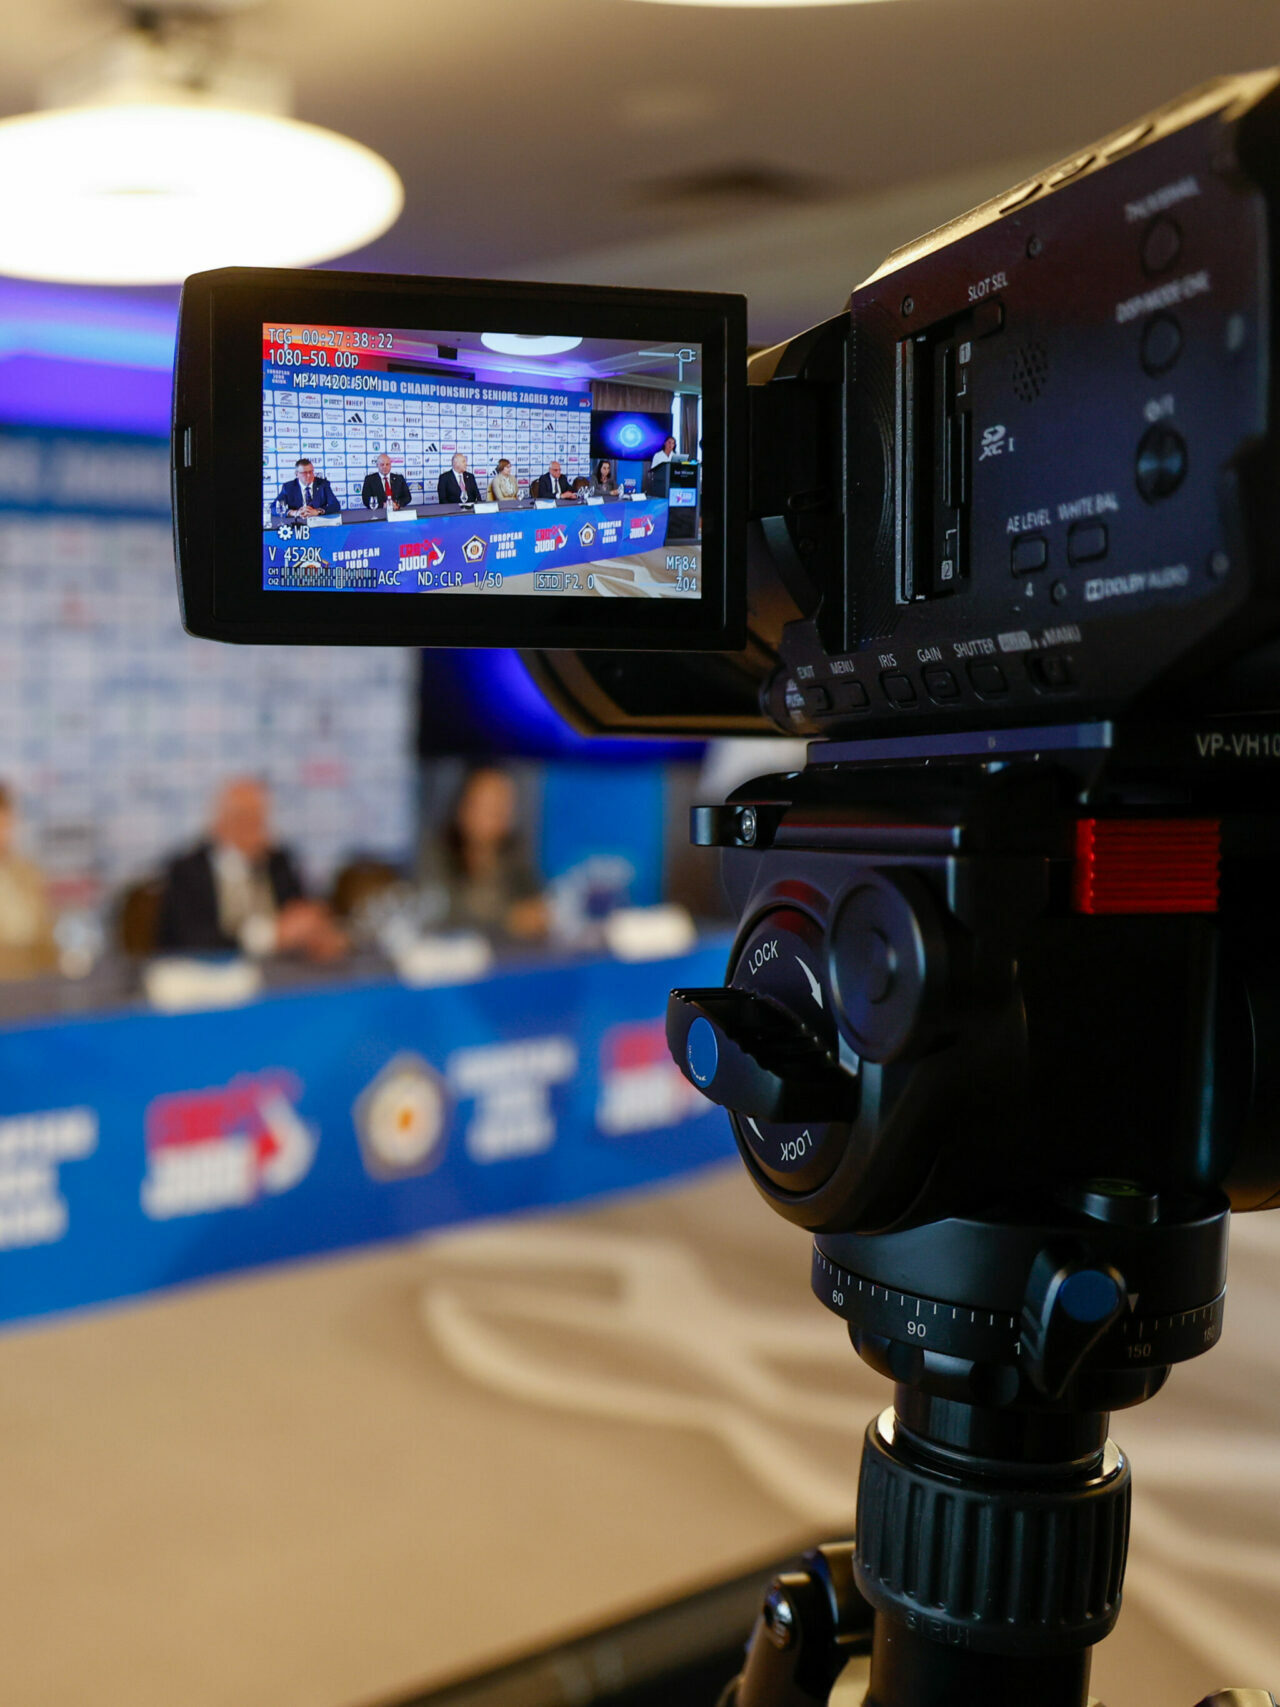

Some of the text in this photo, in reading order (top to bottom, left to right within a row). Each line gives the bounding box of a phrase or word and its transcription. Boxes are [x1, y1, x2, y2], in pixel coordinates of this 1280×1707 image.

[968, 271, 1009, 302] SLOT SEL
[268, 328, 393, 348] TCG 00:27:38:22
[293, 373, 316, 388] MP4
[324, 375, 347, 390] 420
[400, 381, 480, 399] CHAMPIONSHIPS
[482, 390, 518, 403] SENIORS
[519, 393, 549, 404] ZAGREB
[550, 395, 569, 406] 2024
[1006, 491, 1119, 534] AE LEVEL WHITE BAL
[294, 526, 310, 540] WB
[598, 520, 622, 530] EUROPEAN
[490, 531, 523, 543] EUROPEAN
[498, 541, 515, 550] JUDO
[535, 538, 555, 553] JUDO
[268, 546, 321, 562] V 4520K
[332, 547, 380, 562] EUROPEAN
[495, 549, 517, 559] UNION
[398, 555, 428, 572] JUDO
[666, 556, 697, 570] MF84
[378, 570, 400, 585] AGC
[418, 571, 462, 587] ND:CLR
[473, 570, 503, 590] 1/50
[538, 574, 559, 588] STD
[676, 577, 697, 591] Z04
[797, 664, 815, 681] EXIT
[829, 660, 855, 676] MENU
[878, 652, 898, 669] IRIS
[917, 646, 943, 663] GAIN
[952, 637, 996, 659] SHUTTER
[748, 939, 779, 976] LOCK
[780, 1129, 813, 1162] LOCK
[831, 1289, 844, 1306] 60
[907, 1320, 927, 1338] 90
[1127, 1343, 1152, 1359] 150
